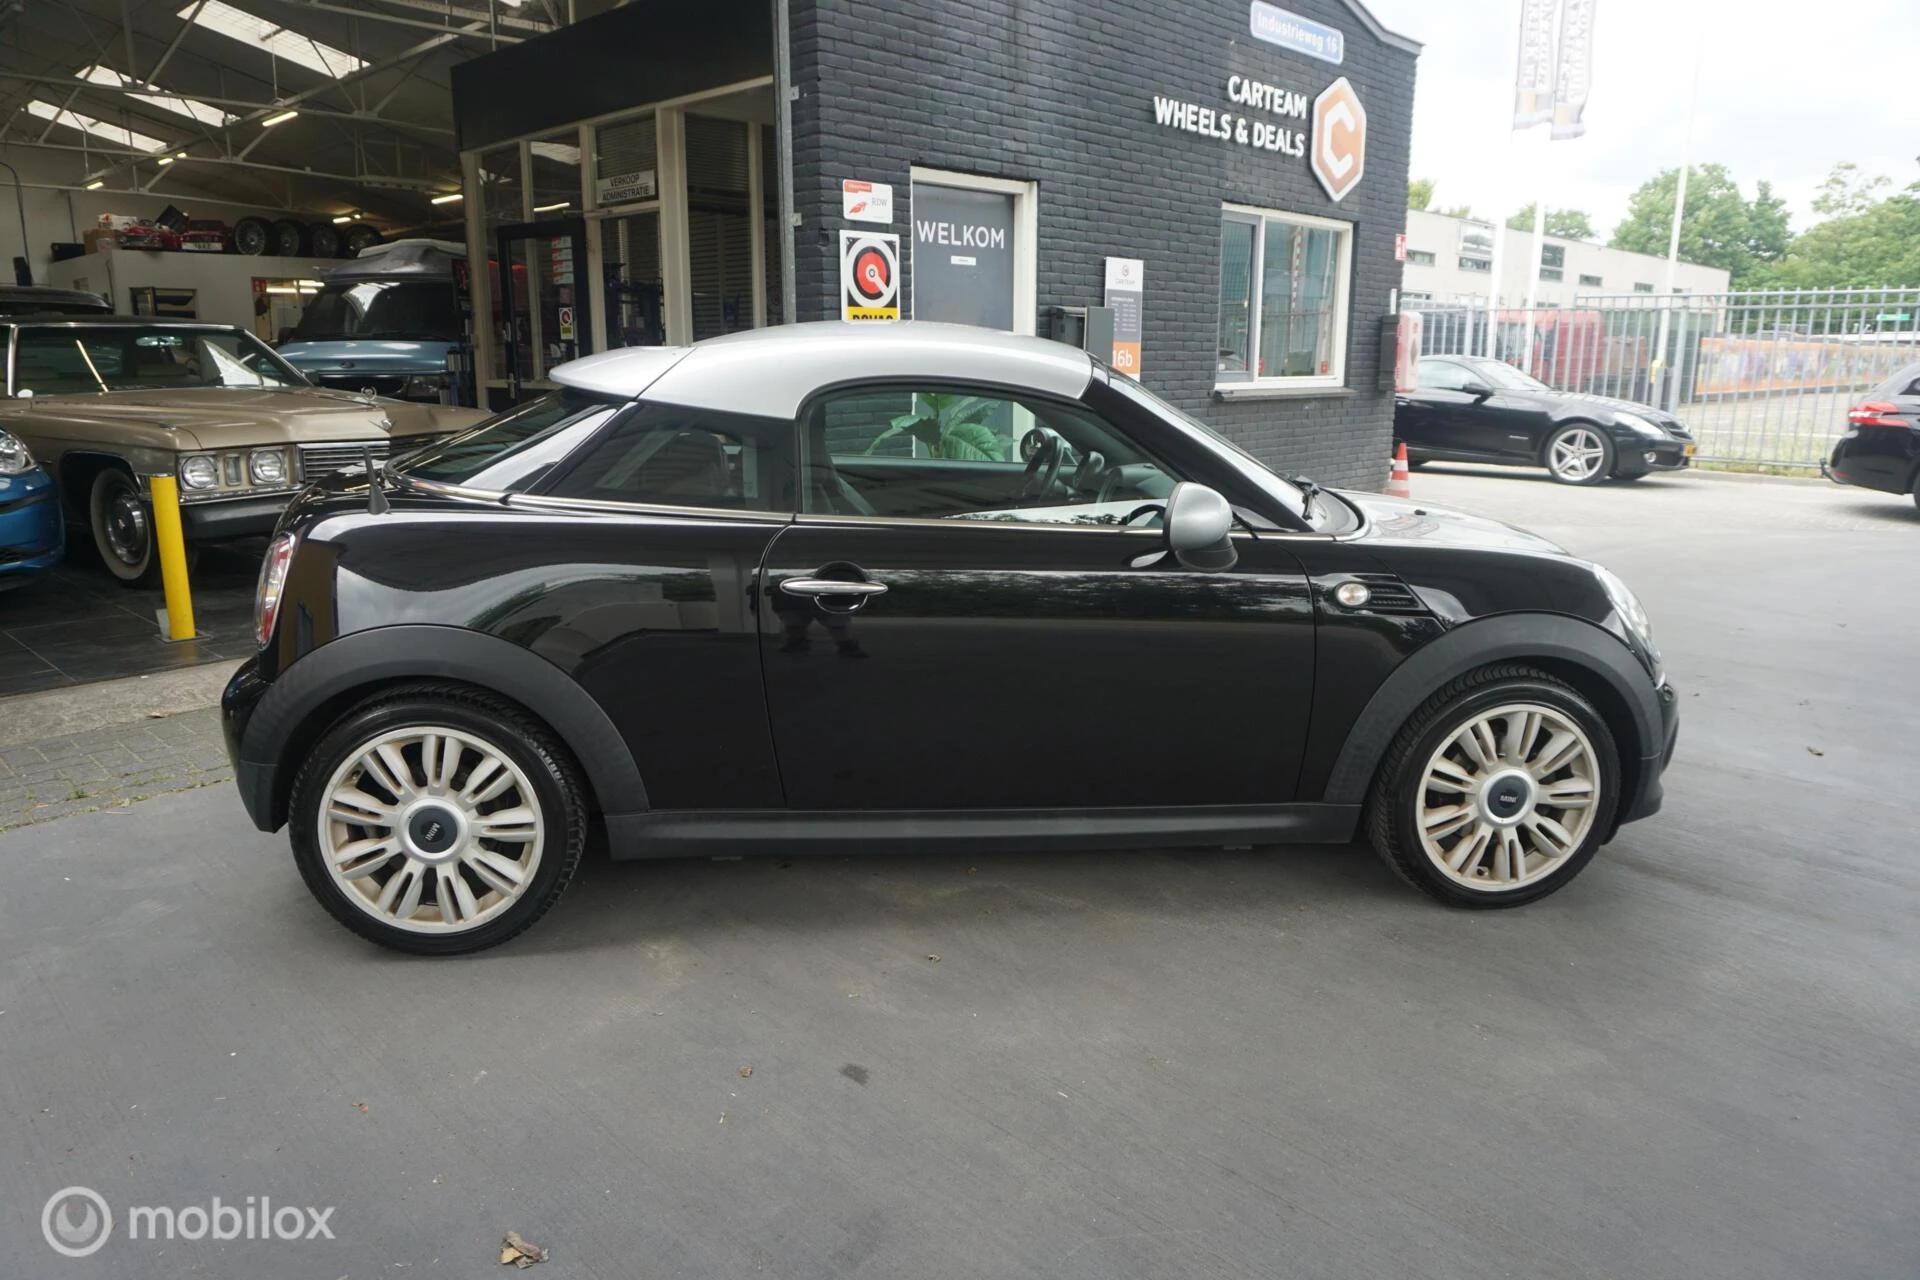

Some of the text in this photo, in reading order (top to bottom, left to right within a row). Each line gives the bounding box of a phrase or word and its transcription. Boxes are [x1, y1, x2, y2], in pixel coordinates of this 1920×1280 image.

[1257, 12, 1324, 52] Industrieweg
[1227, 75, 1307, 119] CARTEAM
[1154, 96, 1306, 158] WHEELS & DEALS
[603, 185, 650, 200] ADMINISTRATIE
[610, 173, 640, 188] VERKOOP
[917, 220, 1005, 249] WELKOM
